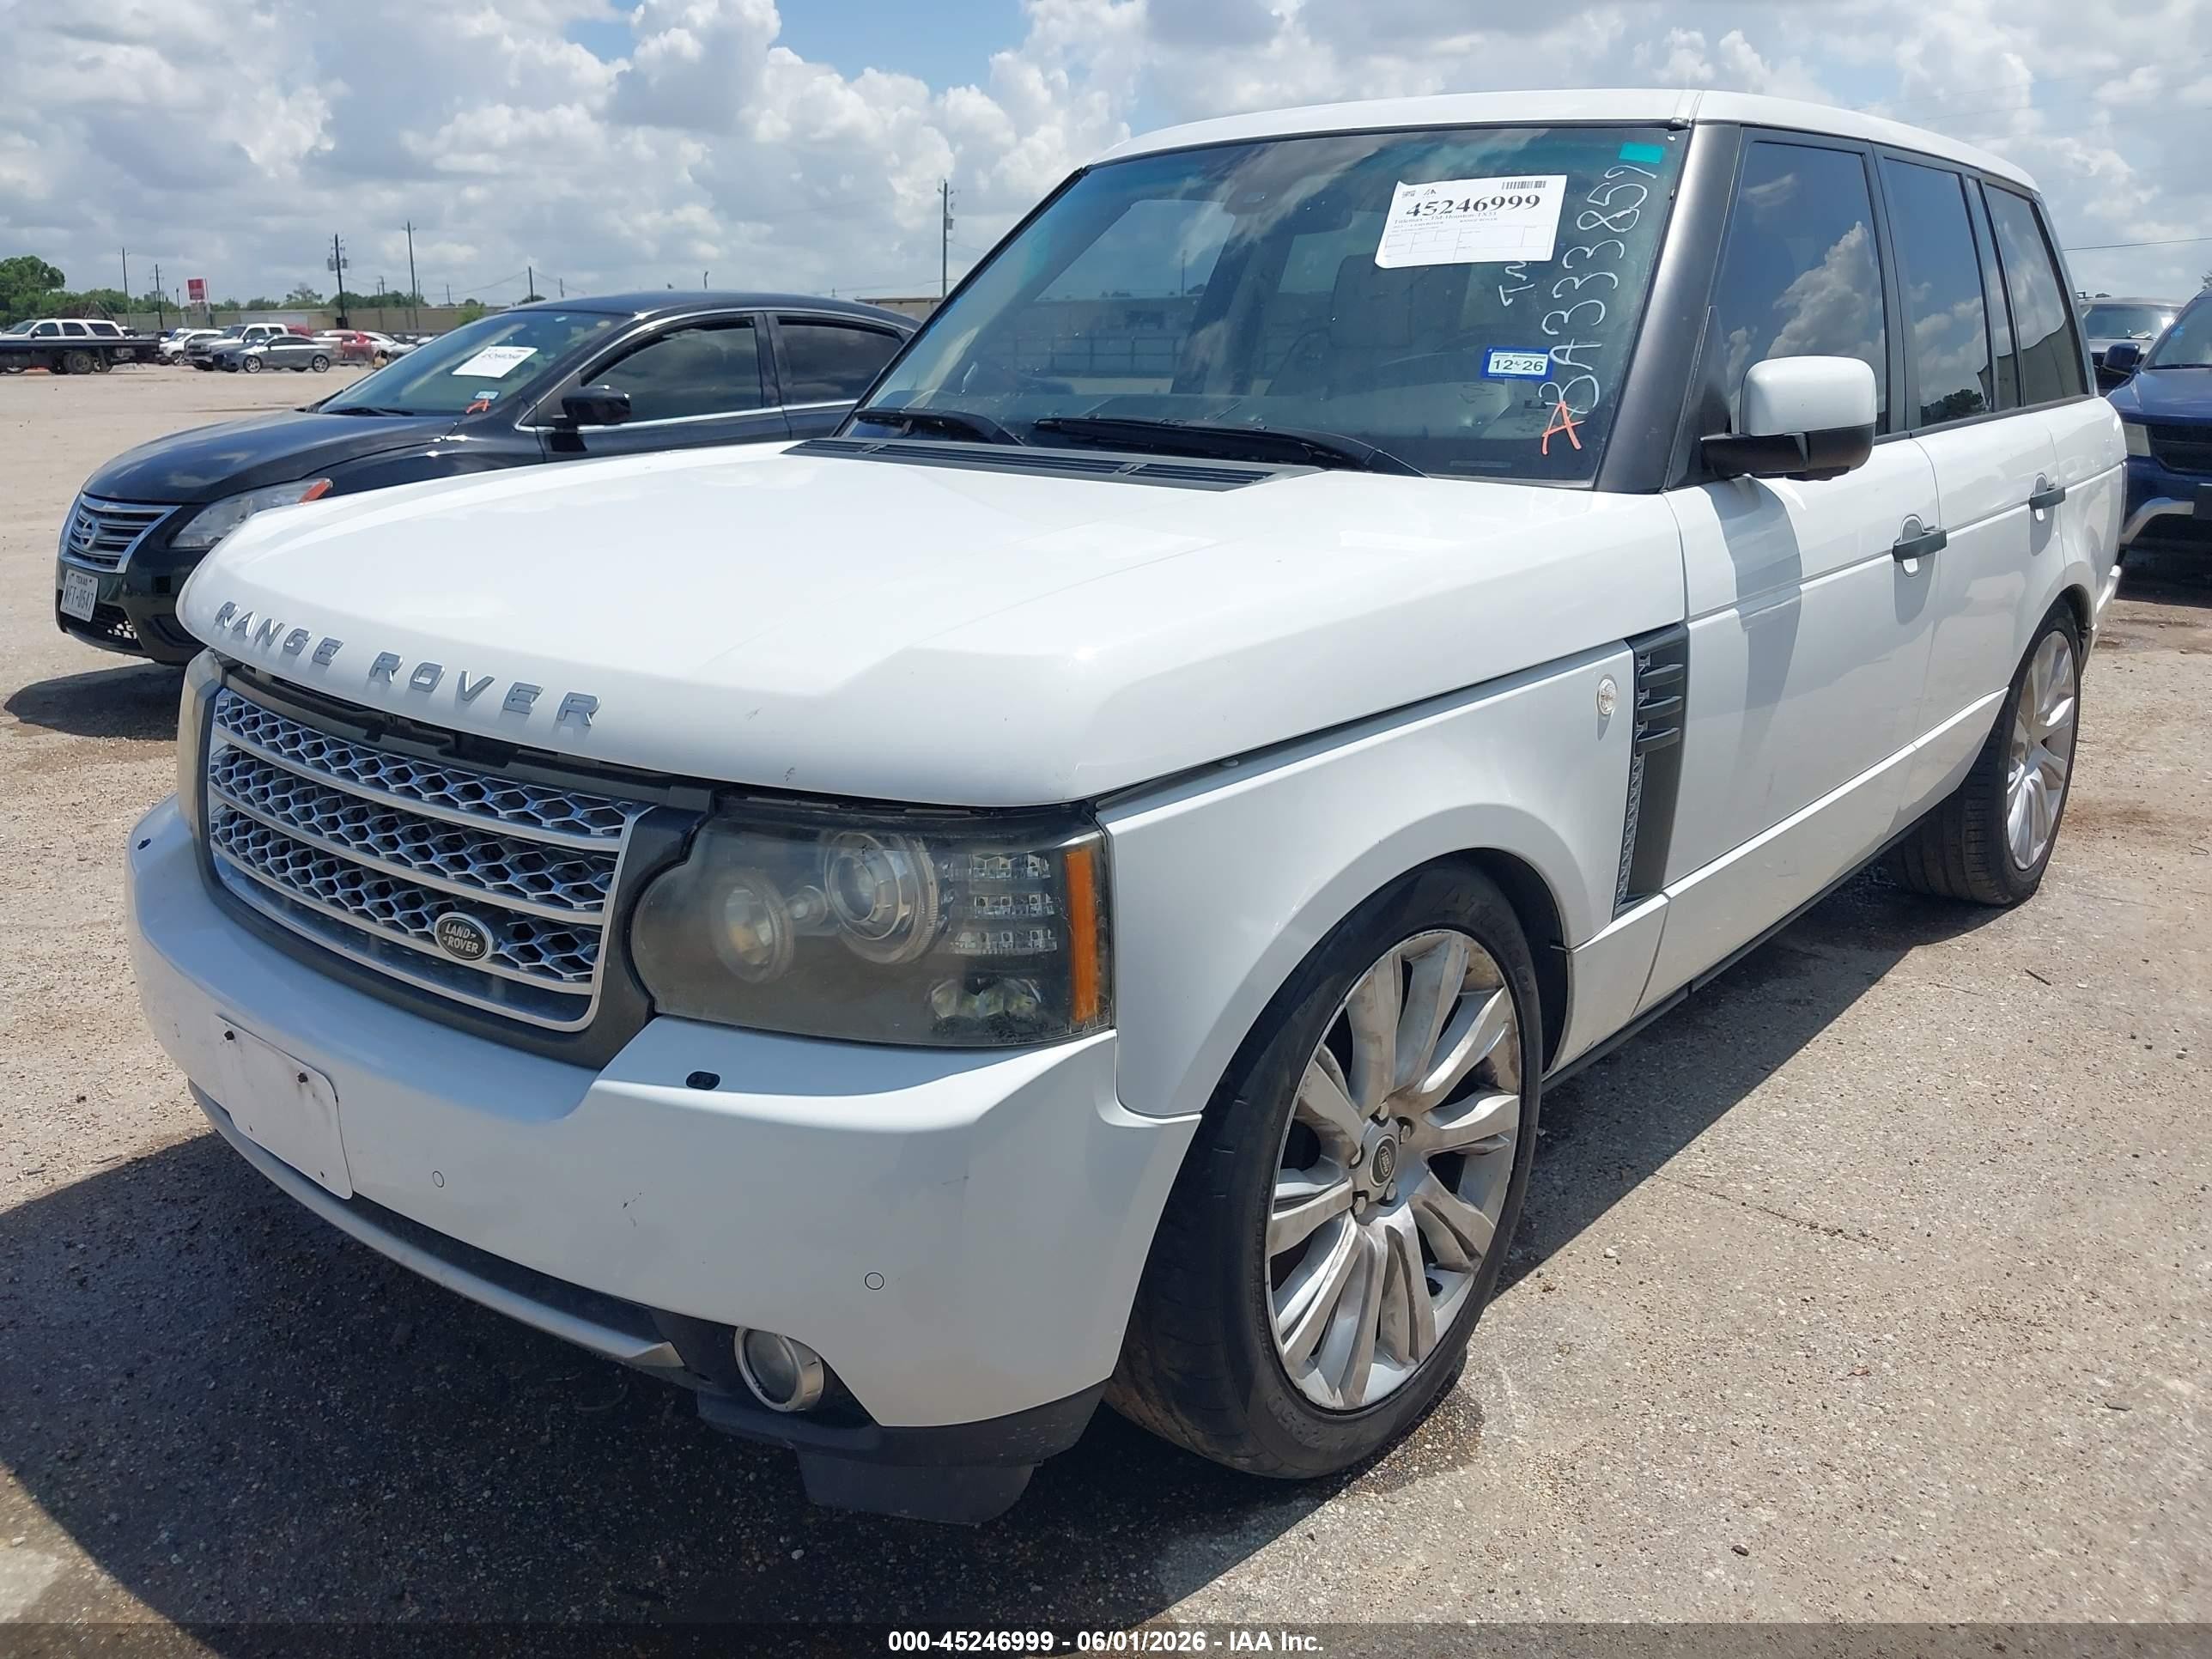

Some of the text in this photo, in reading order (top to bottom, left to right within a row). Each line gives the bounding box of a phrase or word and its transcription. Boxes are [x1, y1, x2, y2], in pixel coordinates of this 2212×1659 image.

[1406, 194, 1541, 217] 45246999
[1493, 359, 1545, 372] 12 26
[214, 600, 602, 727] RANGE ROVER
[444, 922, 471, 939] LAND
[447, 935, 480, 955] ROVER
